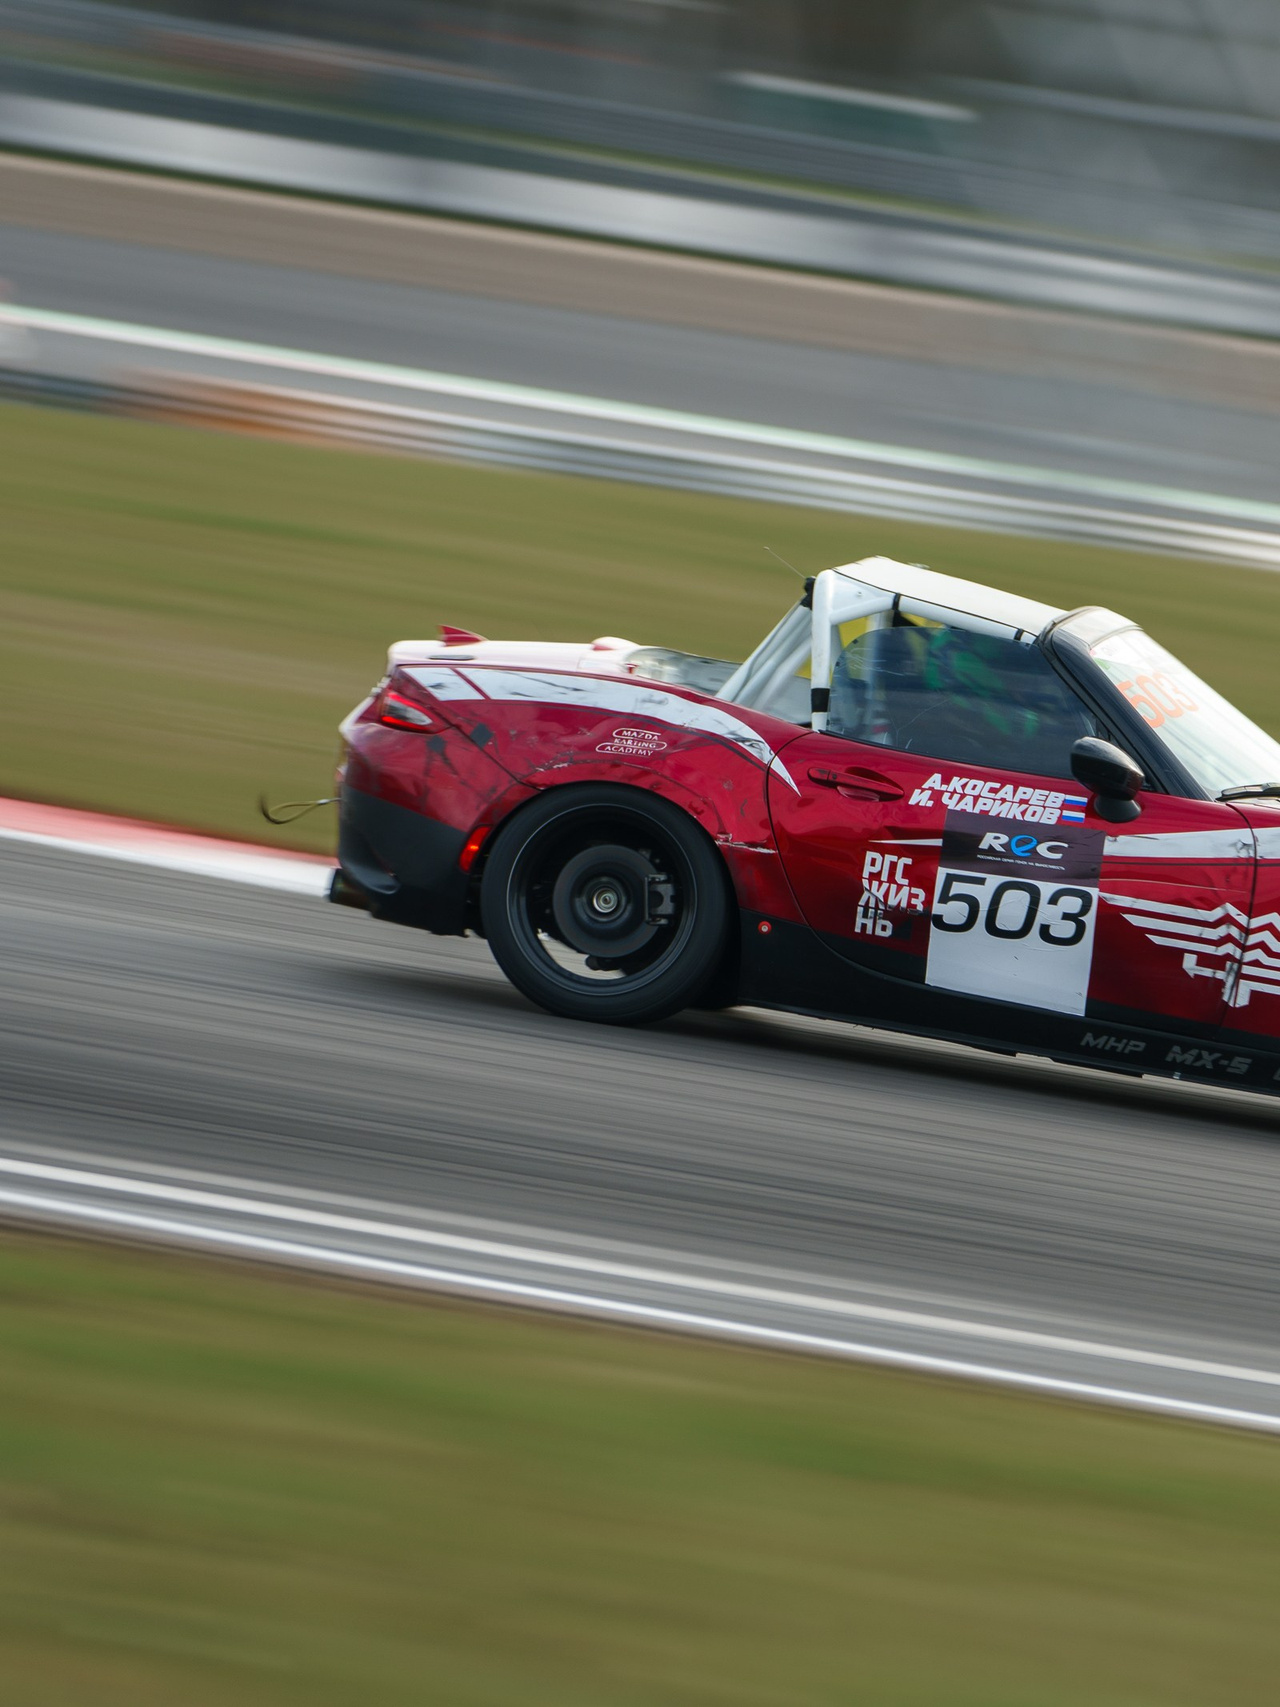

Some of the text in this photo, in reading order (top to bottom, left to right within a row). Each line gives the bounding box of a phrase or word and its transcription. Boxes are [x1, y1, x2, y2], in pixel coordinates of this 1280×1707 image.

[1117, 669, 1199, 728] 503
[604, 745, 654, 757] ACADEMY
[621, 731, 659, 741] MAZDA
[908, 789, 1061, 825] И. ЧАРИКОВ
[922, 773, 1066, 808] А.КОСАРЕВ
[862, 851, 913, 886] РГС
[858, 878, 926, 915] ЖИЗ
[931, 873, 1092, 946] 503
[854, 906, 893, 937] НЬ
[1080, 1032, 1146, 1054] MHP
[1164, 1045, 1253, 1074] MX-5
